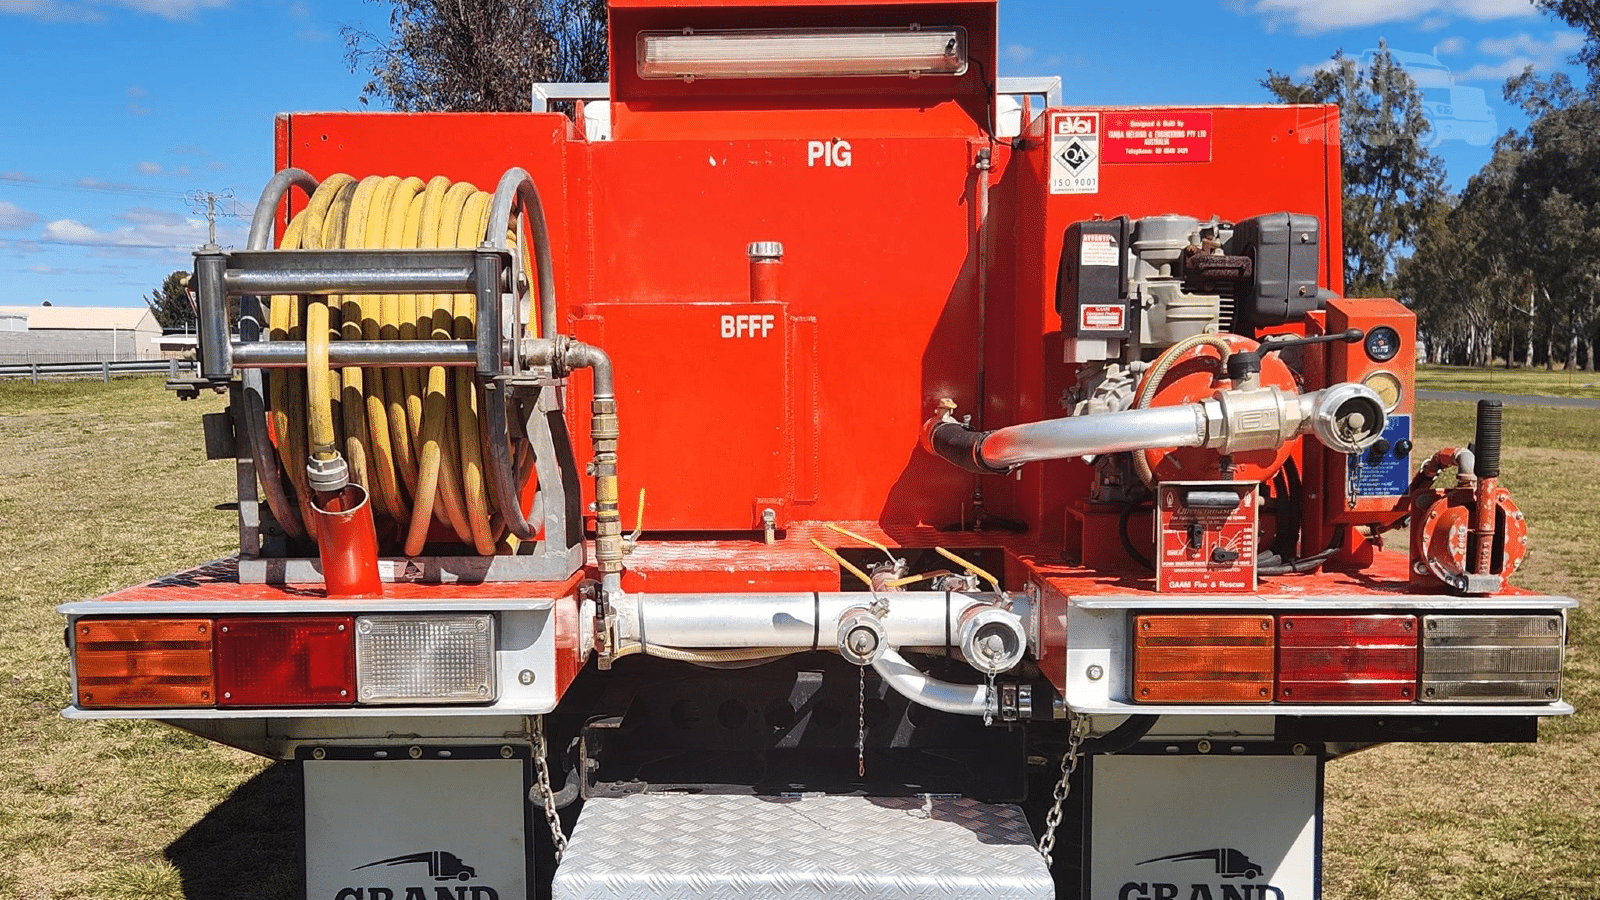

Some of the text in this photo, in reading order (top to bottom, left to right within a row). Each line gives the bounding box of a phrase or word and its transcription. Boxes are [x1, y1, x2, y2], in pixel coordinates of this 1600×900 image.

[1130, 120, 1155, 128] Designed
[1177, 120, 1184, 128] by
[1125, 130, 1147, 138] WELDING
[1148, 130, 1153, 138] &
[1154, 130, 1186, 138] ENGINEERING
[1186, 130, 1196, 138] PTY
[1197, 130, 1207, 138] LTD
[1144, 138, 1170, 146] AUSTRALIA
[808, 140, 852, 167] PIG
[1064, 147, 1086, 164] QA
[1054, 178, 1096, 187] ISO 9001
[721, 315, 775, 338] BFFF
